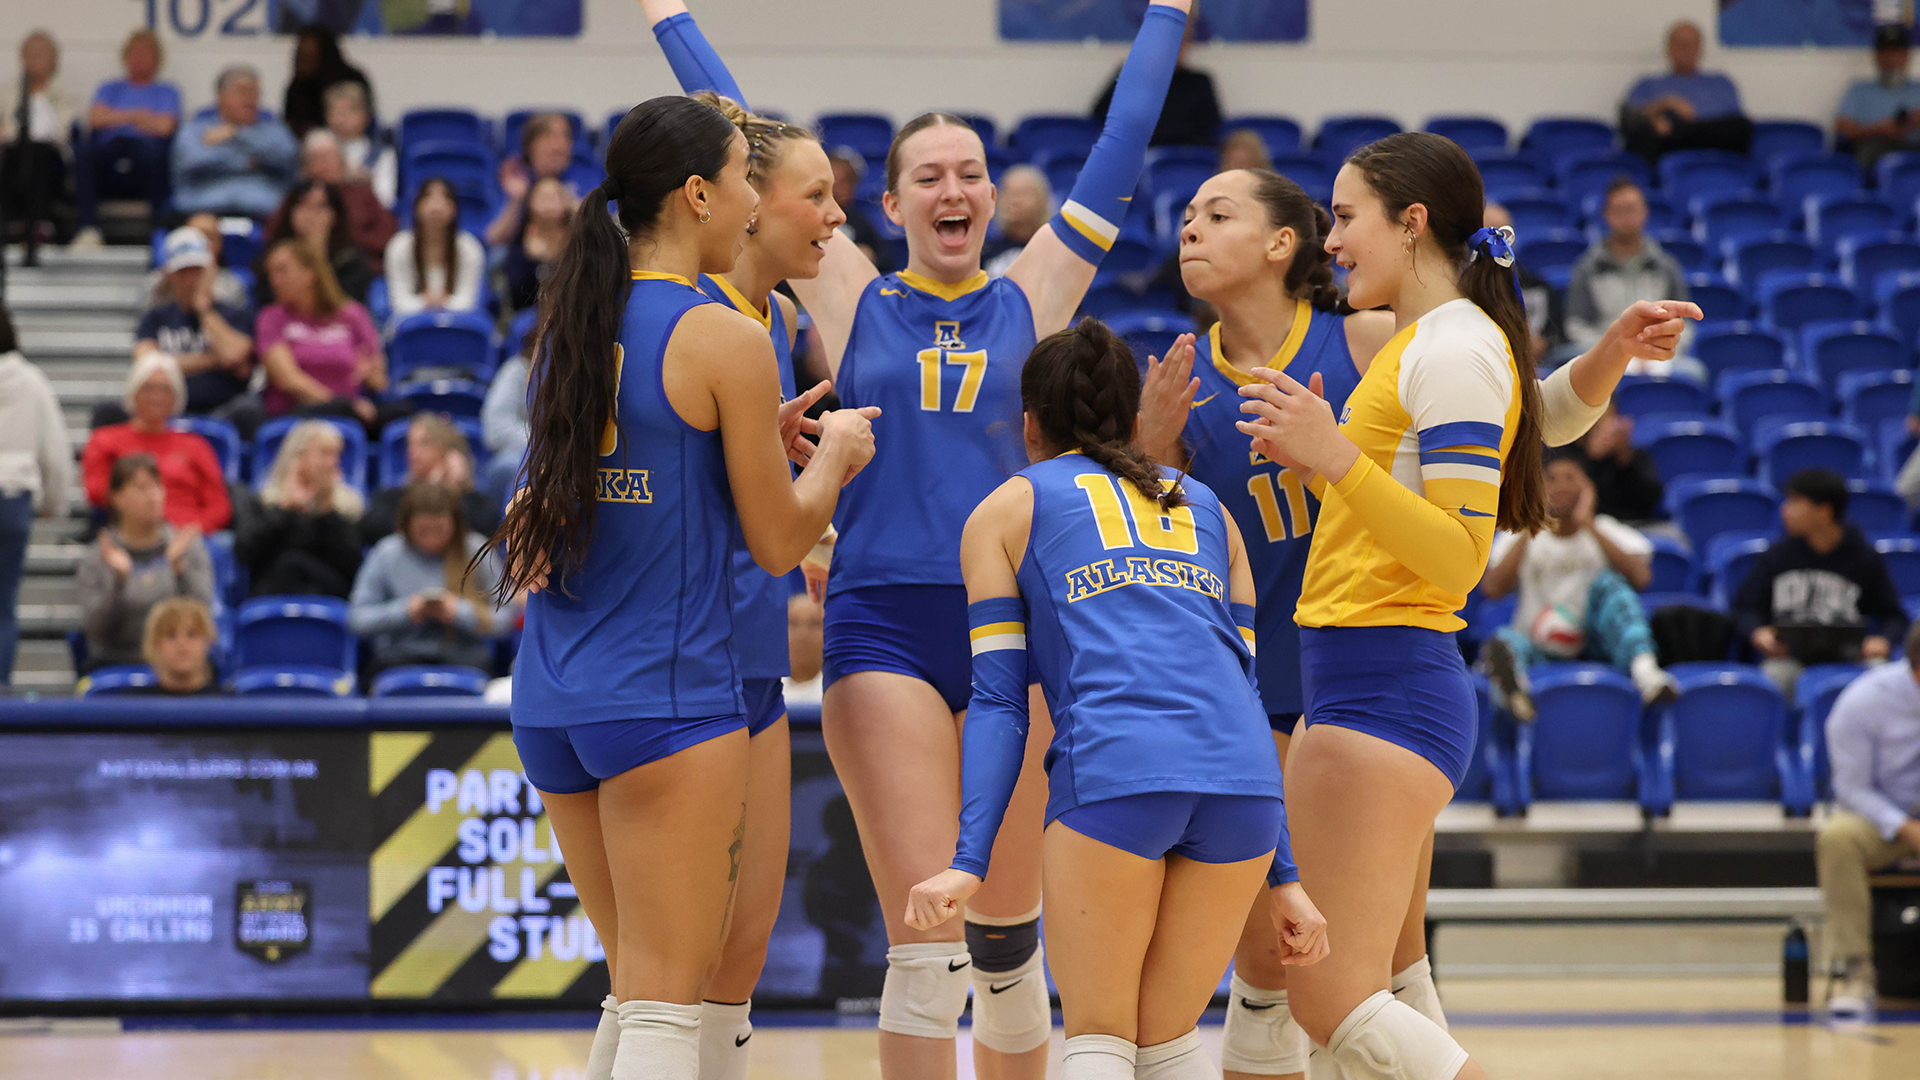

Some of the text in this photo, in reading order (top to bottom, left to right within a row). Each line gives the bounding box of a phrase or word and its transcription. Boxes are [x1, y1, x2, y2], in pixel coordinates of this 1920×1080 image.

[916, 347, 988, 413] 17
[596, 468, 653, 503] KA
[1074, 473, 1199, 555] 16
[1247, 468, 1311, 543] 11
[1065, 557, 1224, 603] ALASKA
